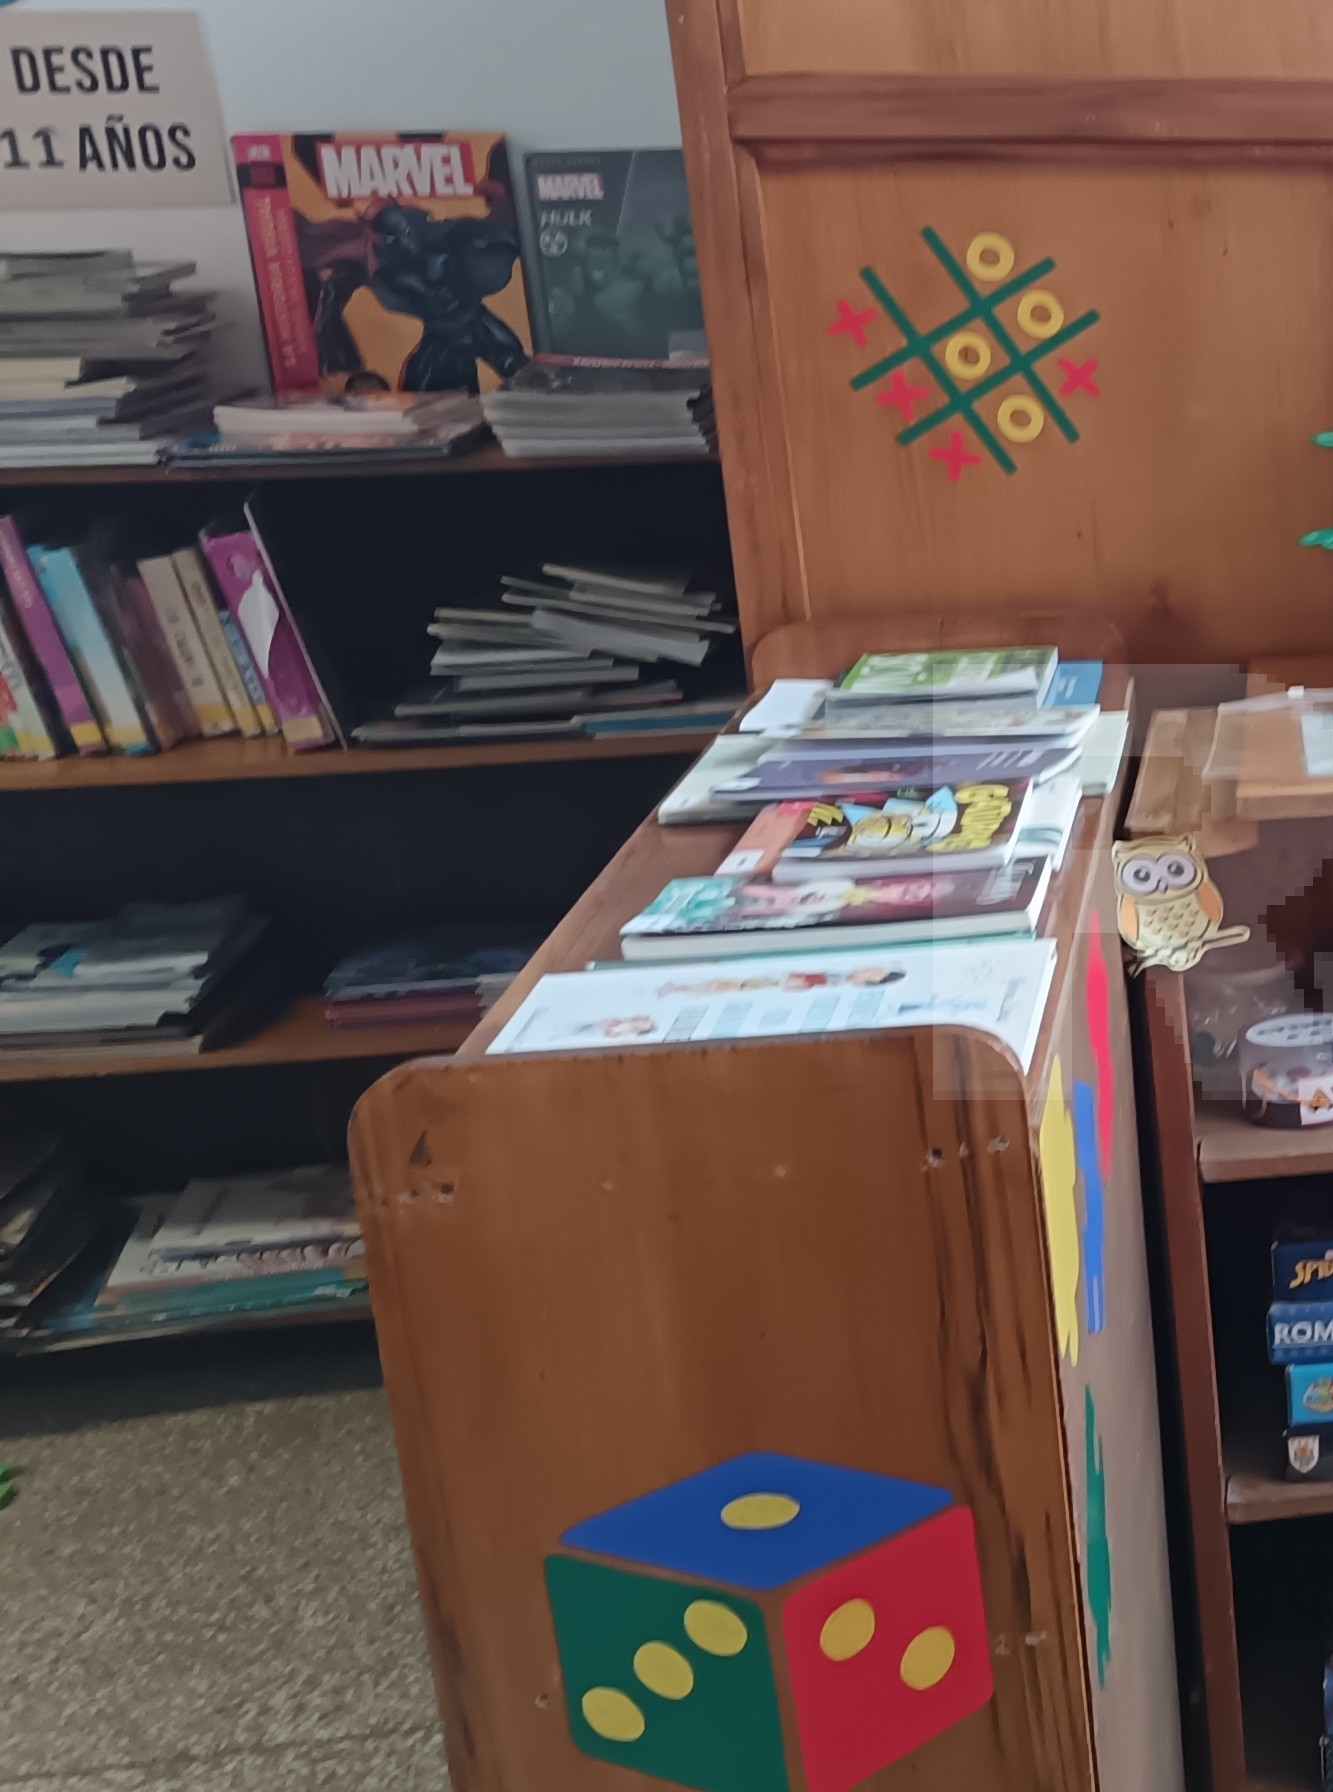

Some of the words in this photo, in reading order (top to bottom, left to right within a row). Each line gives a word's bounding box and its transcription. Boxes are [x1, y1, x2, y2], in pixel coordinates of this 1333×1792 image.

[10, 45, 161, 94] DESDE
[1, 127, 64, 169] 11
[78, 114, 197, 171] AÑOS
[320, 143, 474, 199] MARVEL
[537, 173, 604, 200] MARVEL
[540, 209, 593, 227] HULK
